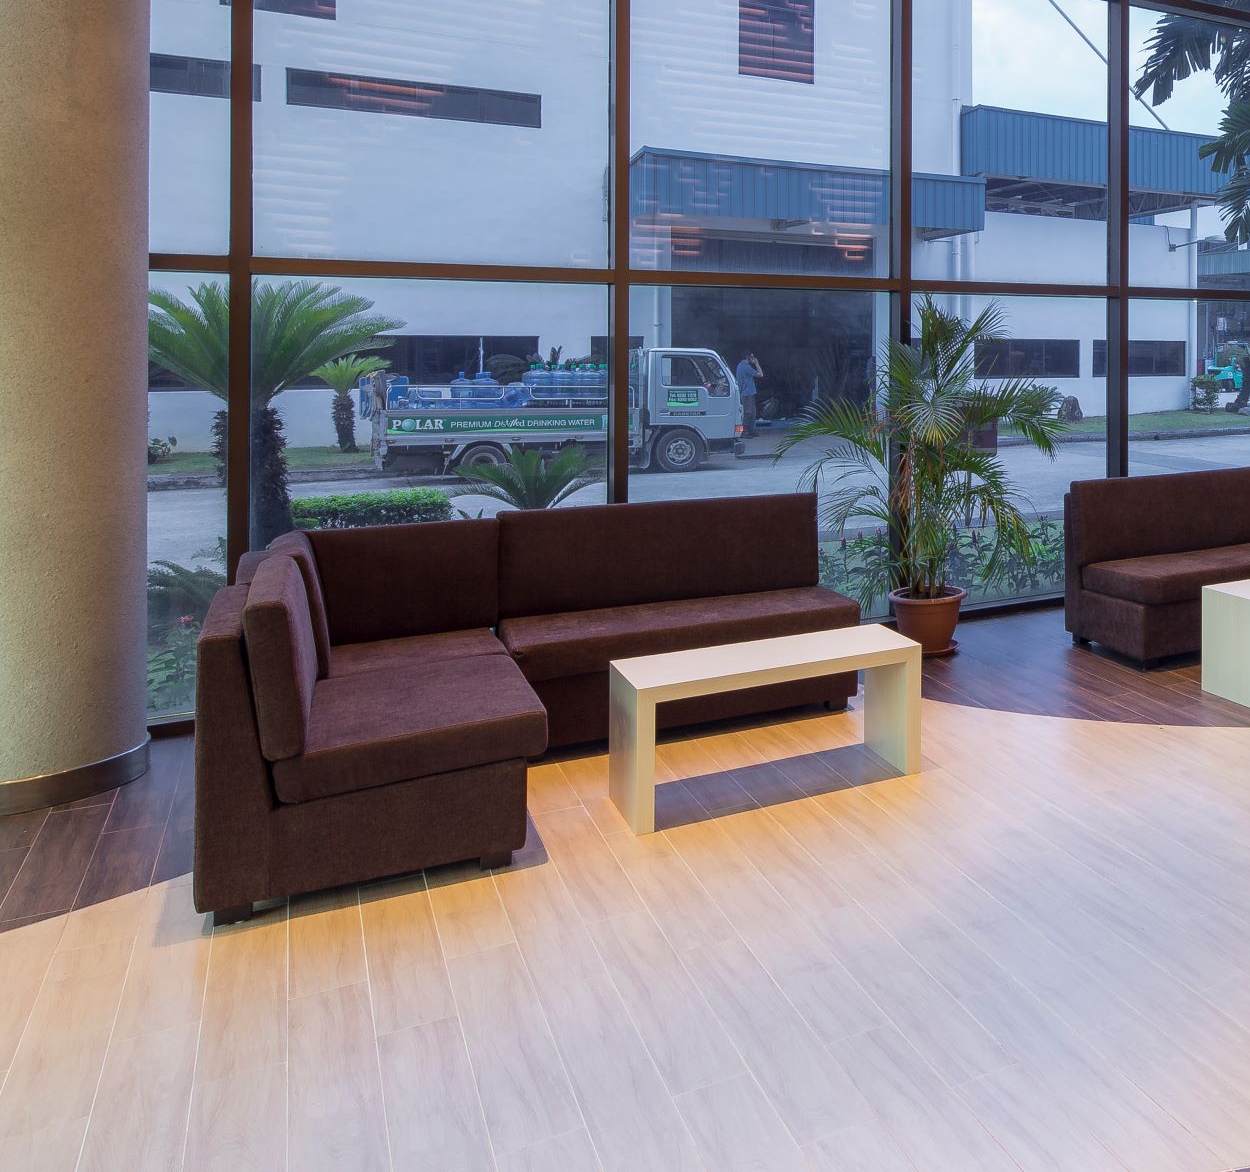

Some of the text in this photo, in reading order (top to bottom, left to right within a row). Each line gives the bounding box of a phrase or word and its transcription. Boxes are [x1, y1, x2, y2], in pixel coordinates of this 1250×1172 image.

[391, 418, 444, 431] POLAR
[450, 420, 492, 429] PREMIUM
[527, 419, 567, 428] DRINKING
